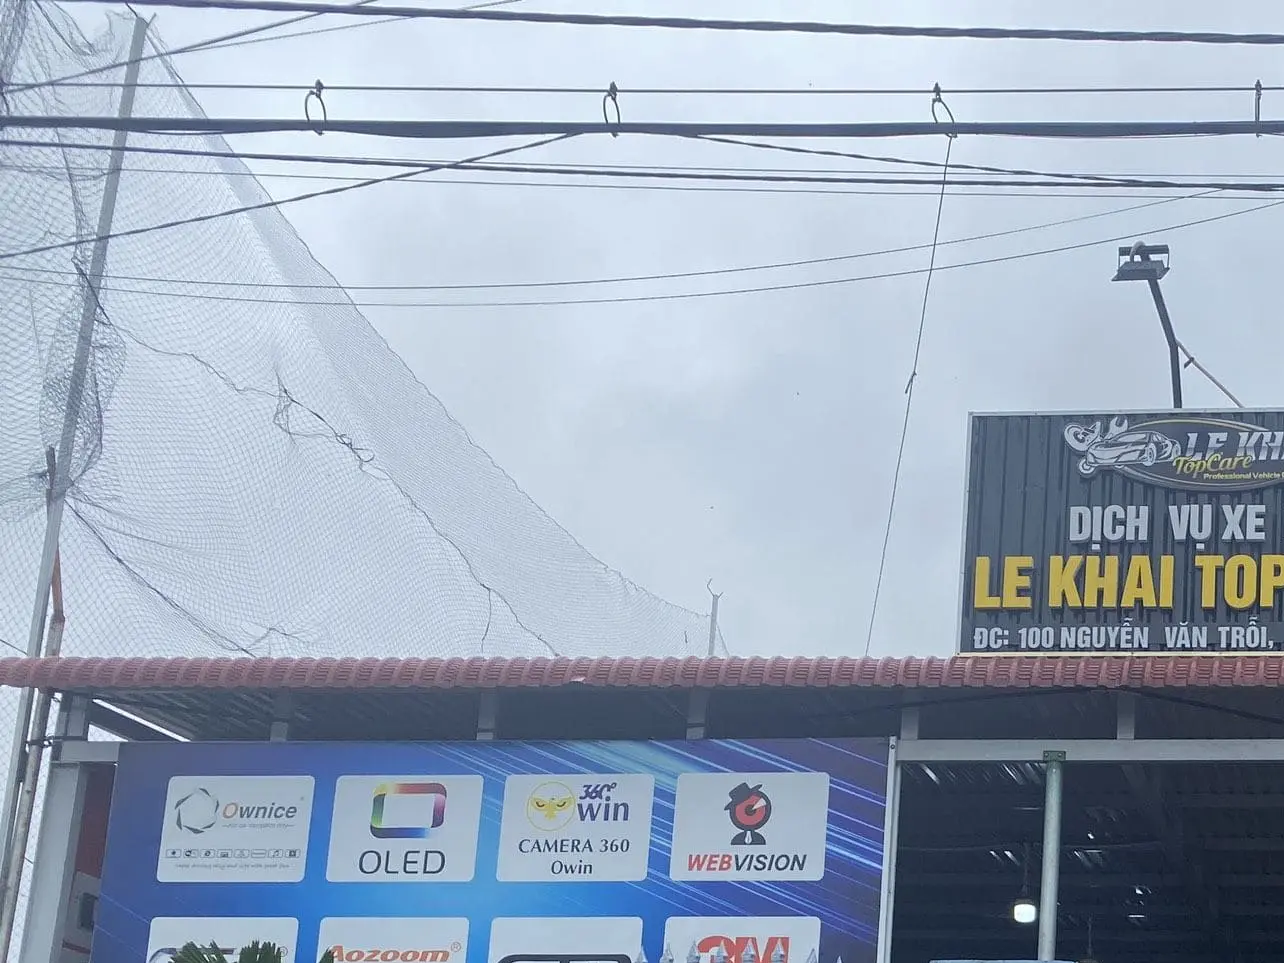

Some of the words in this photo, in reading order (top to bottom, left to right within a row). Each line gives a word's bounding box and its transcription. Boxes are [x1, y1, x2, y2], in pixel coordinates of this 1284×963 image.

[1186, 432, 1229, 459] LE
[1069, 504, 1149, 550] DỊCH
[1168, 504, 1212, 549] VỤ
[1221, 504, 1266, 540] XE
[974, 556, 1034, 609] LE
[1048, 555, 1174, 609] KHAI
[974, 627, 1009, 649] ĐC:
[1018, 627, 1054, 649] 100
[1060, 617, 1149, 649] NGUYỄN
[1165, 621, 1208, 649] VĂN
[1218, 614, 1274, 649] TRỖI,
[222, 802, 298, 819] Ownice
[518, 838, 593, 854] CAMERA
[600, 838, 630, 853] 360
[358, 850, 446, 875] OLED
[550, 860, 593, 875] Owin
[687, 854, 807, 872] WEBVISION
[330, 945, 450, 962] Aozoom
